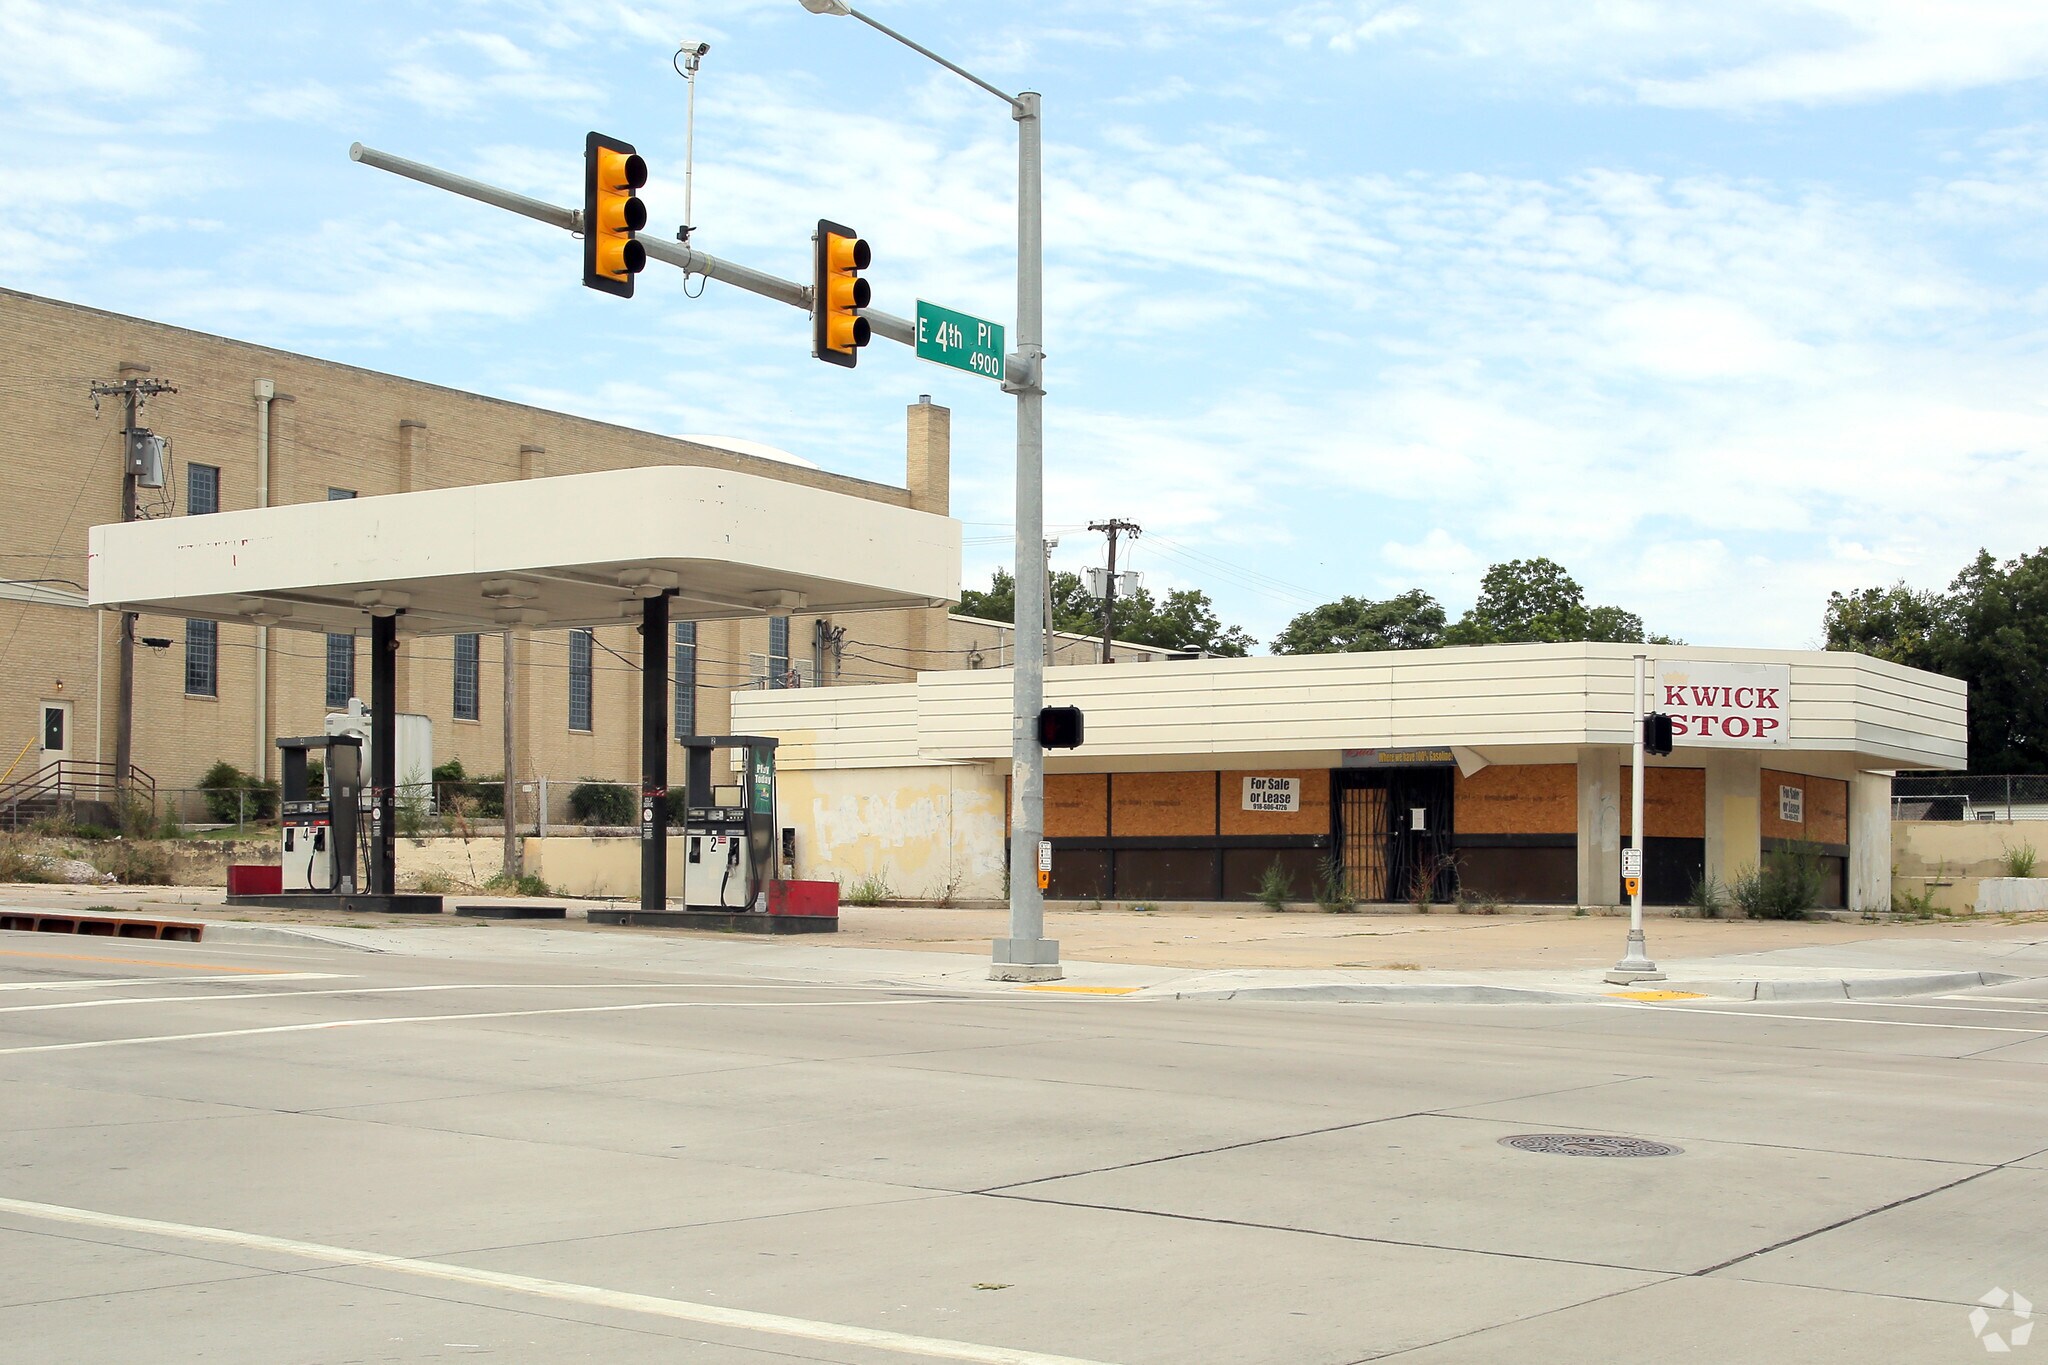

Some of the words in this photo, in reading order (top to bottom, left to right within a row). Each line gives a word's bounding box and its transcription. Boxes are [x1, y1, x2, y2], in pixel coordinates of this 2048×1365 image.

[919, 316, 928, 343] E
[935, 320, 963, 352] 4th
[977, 322, 992, 349] Pl
[969, 351, 999, 376] 4900
[1663, 685, 1780, 709] KWICK
[1666, 714, 1780, 738] STOP
[756, 764, 770, 775] Play
[754, 774, 772, 785] Today
[1250, 777, 1267, 790] For
[1268, 778, 1290, 791] Sale
[1250, 792, 1261, 803] or
[1262, 791, 1291, 804] Lease
[303, 827, 309, 841] 4
[710, 836, 717, 853] 2
